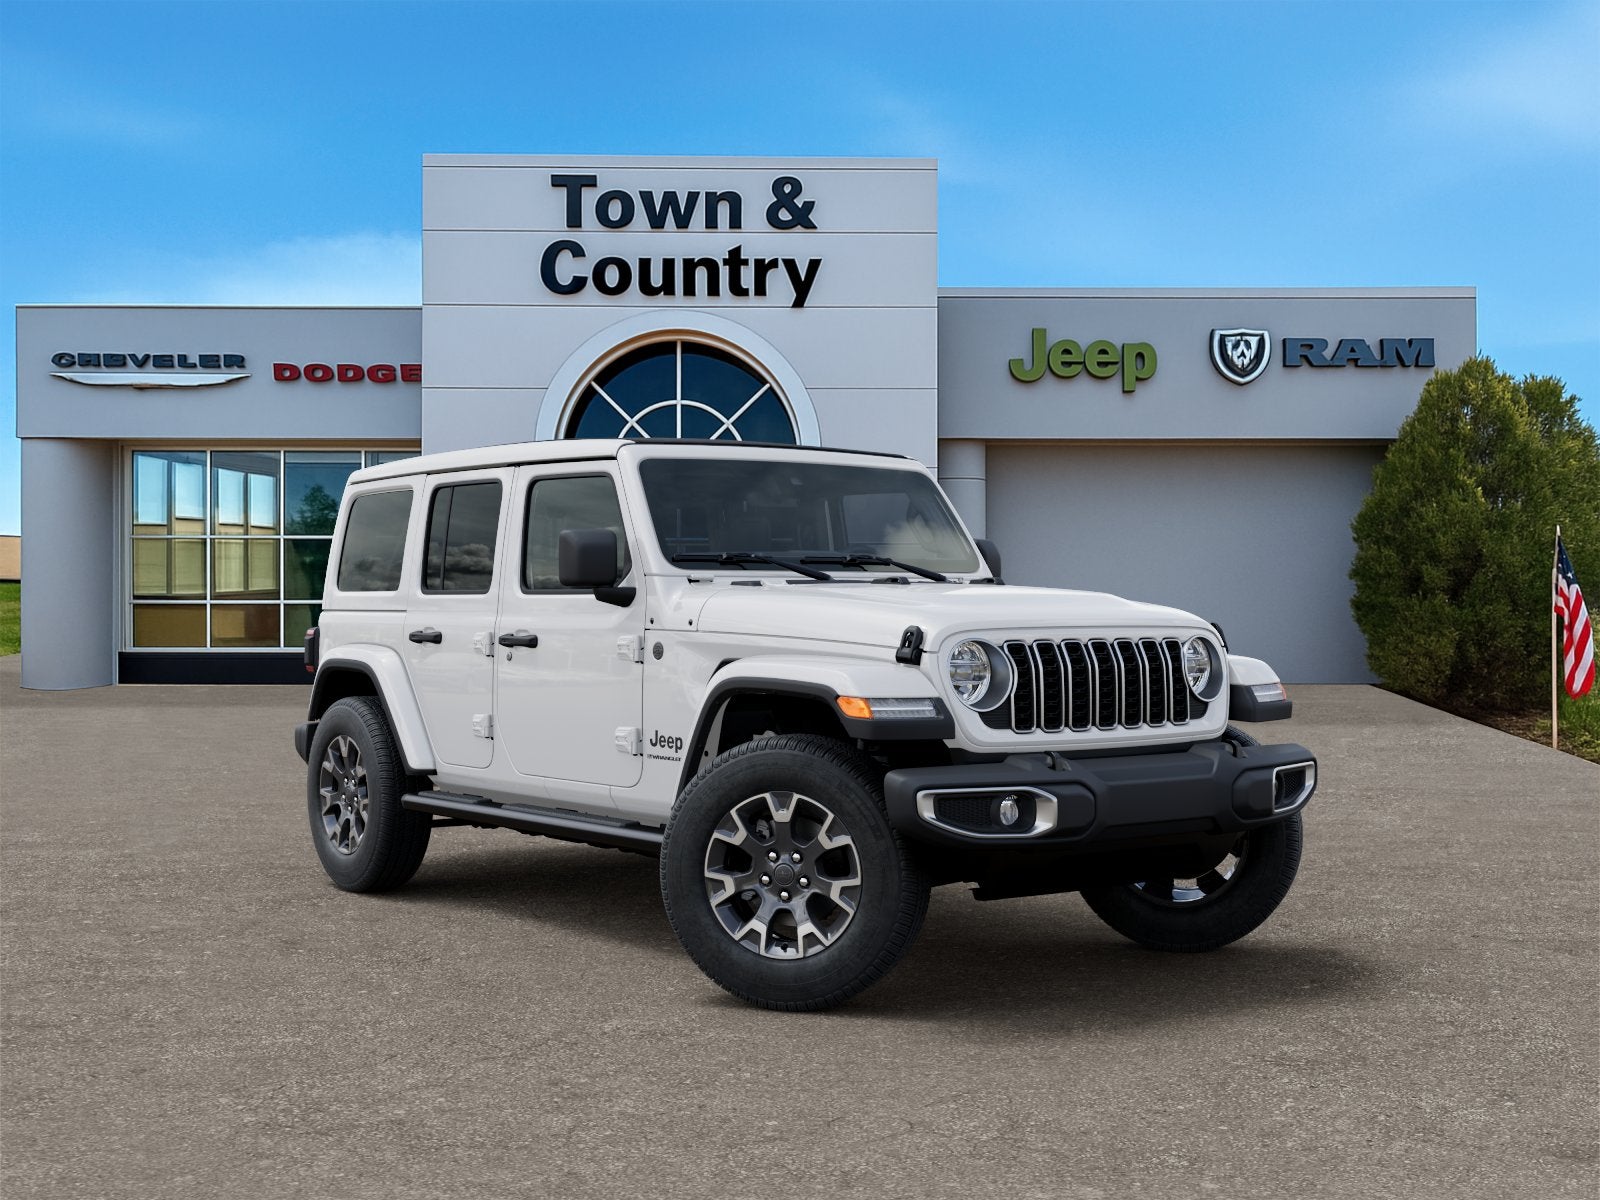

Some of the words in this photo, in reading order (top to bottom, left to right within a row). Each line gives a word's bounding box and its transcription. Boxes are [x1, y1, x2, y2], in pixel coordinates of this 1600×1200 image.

[551, 174, 742, 229] Town
[766, 176, 818, 230] &
[540, 240, 822, 308] Country
[273, 363, 422, 383] DODGE
[1009, 328, 1158, 393] Jeep
[1283, 338, 1435, 367] RAM
[649, 729, 683, 754] Jeep
